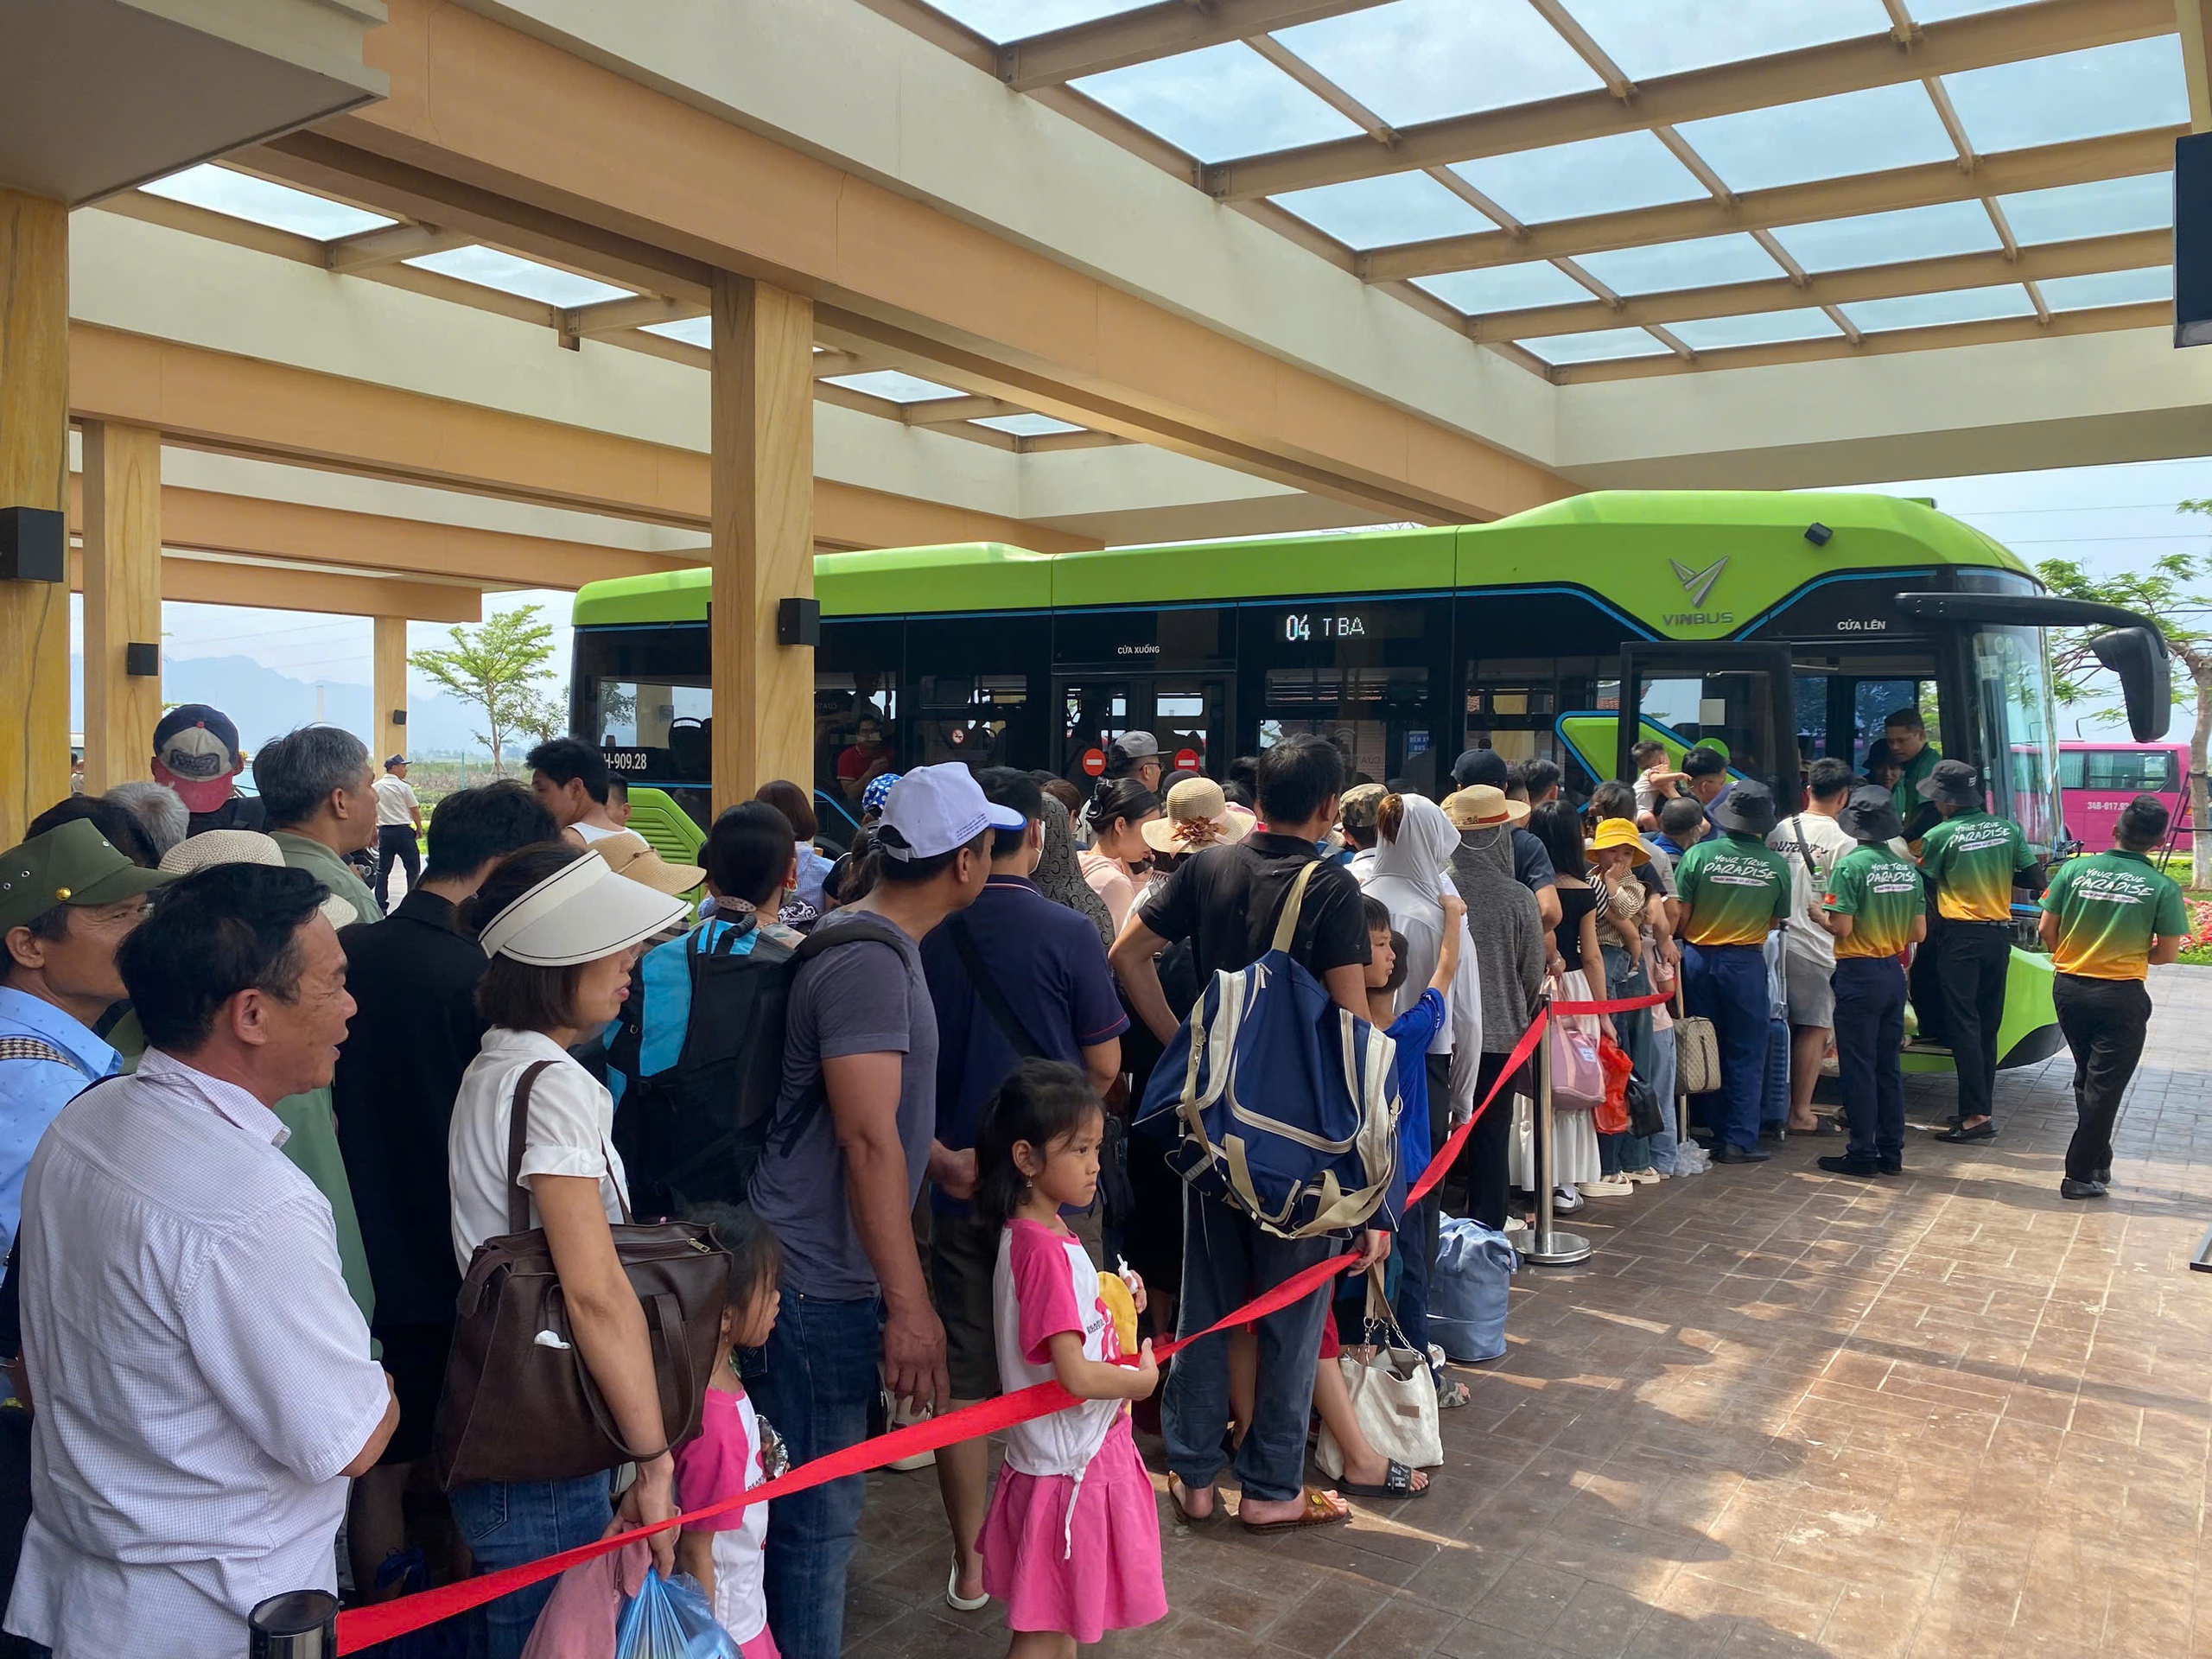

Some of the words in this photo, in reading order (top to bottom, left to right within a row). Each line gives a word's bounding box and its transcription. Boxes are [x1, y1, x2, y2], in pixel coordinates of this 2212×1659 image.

[1286, 613, 1310, 640] 04
[1662, 612, 1733, 626] VINBUS
[1864, 619, 1886, 630] LÊN
[1134, 644, 1160, 654] XUỐNG
[1949, 827, 2010, 848] PARADISE
[1714, 855, 1739, 864] YOUR
[1740, 857, 1770, 868] TRUE
[1702, 862, 1777, 880] PARADISE
[2086, 868, 2113, 880] YOUR
[2114, 872, 2146, 883] TRUE
[1866, 871, 1916, 887] PARADISE
[2071, 875, 2154, 896] PARADISE
